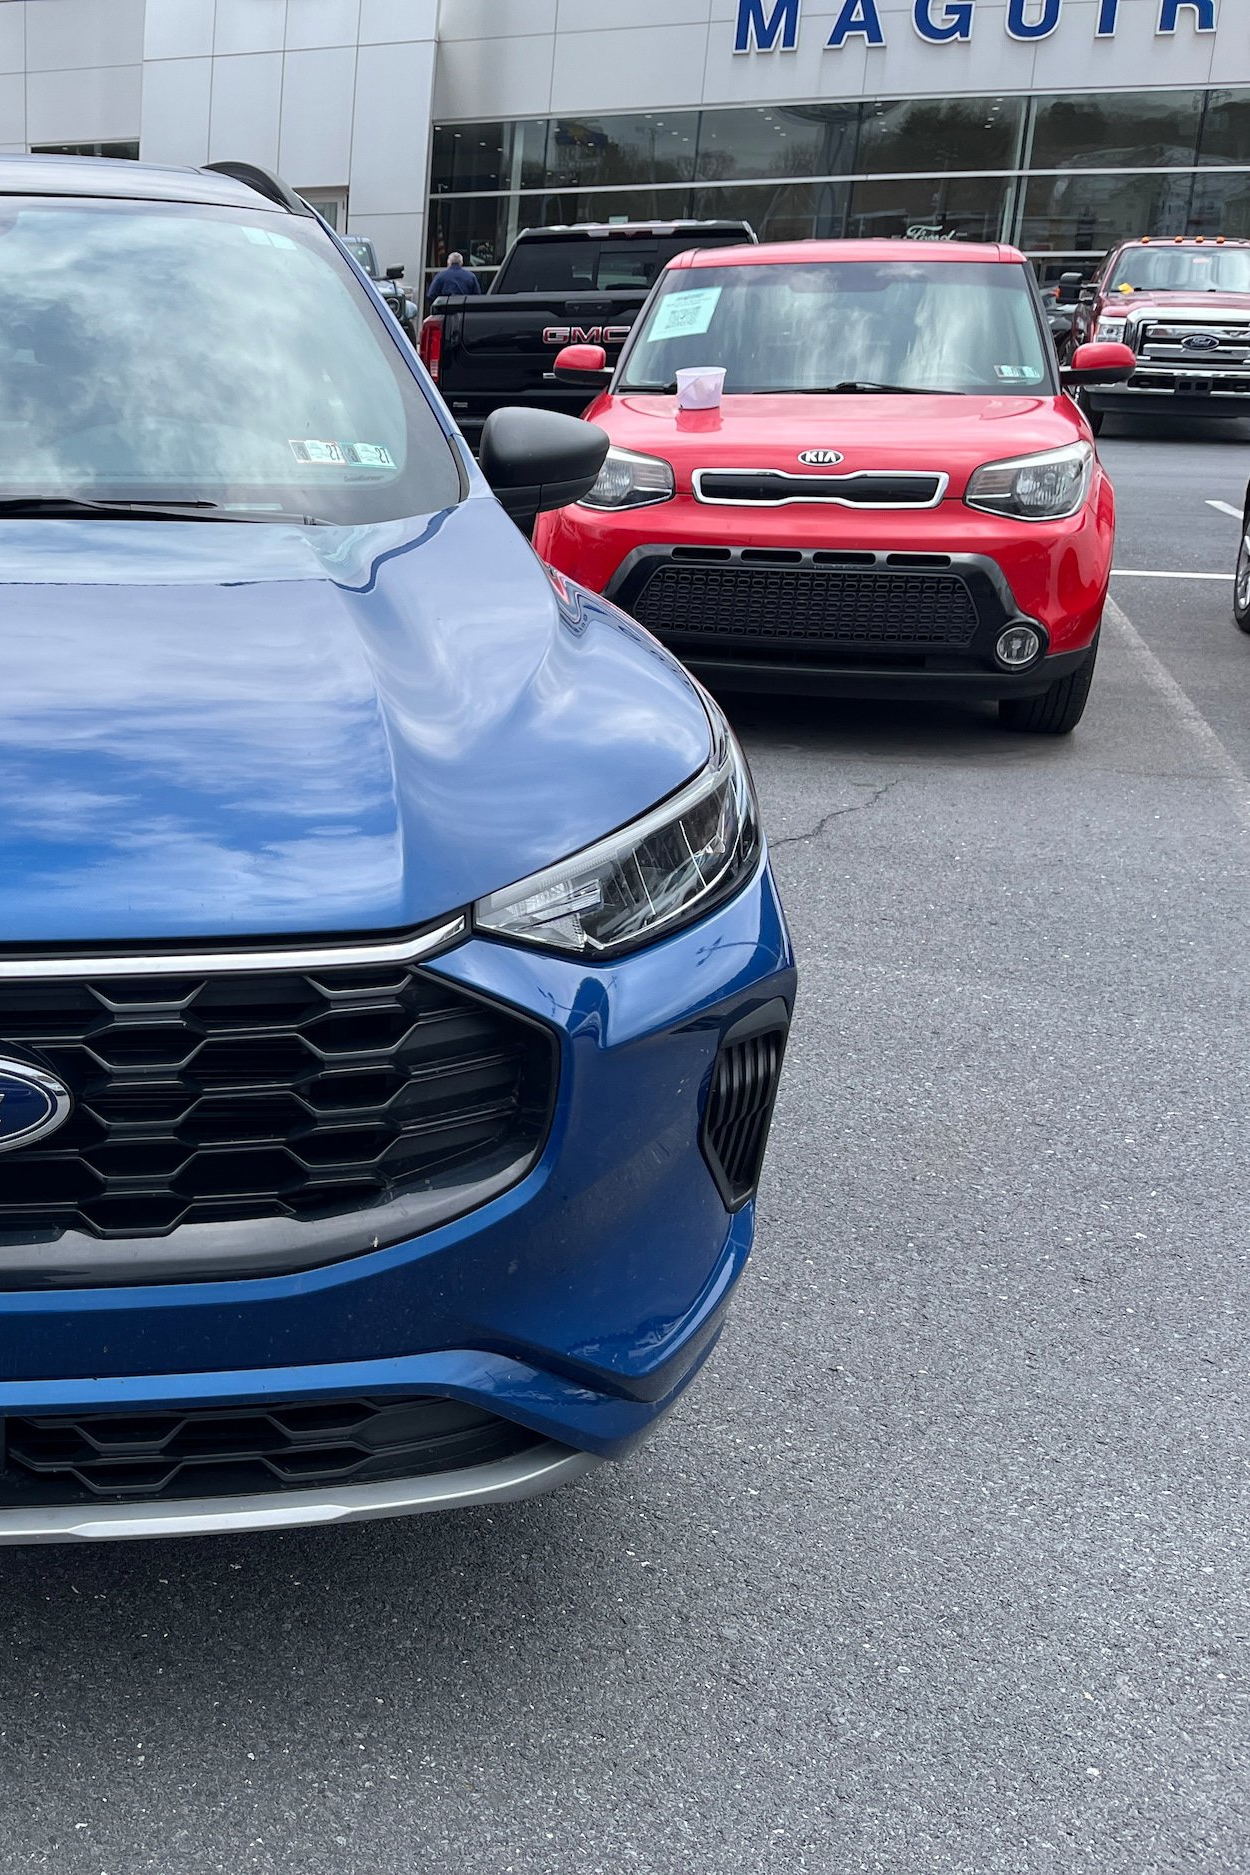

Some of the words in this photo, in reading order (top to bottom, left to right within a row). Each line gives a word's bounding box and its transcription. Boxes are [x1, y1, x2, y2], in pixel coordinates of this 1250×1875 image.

[543, 326, 631, 344] GMC
[326, 444, 341, 461] 27
[375, 447, 390, 464] 27
[805, 451, 837, 463] KIA
